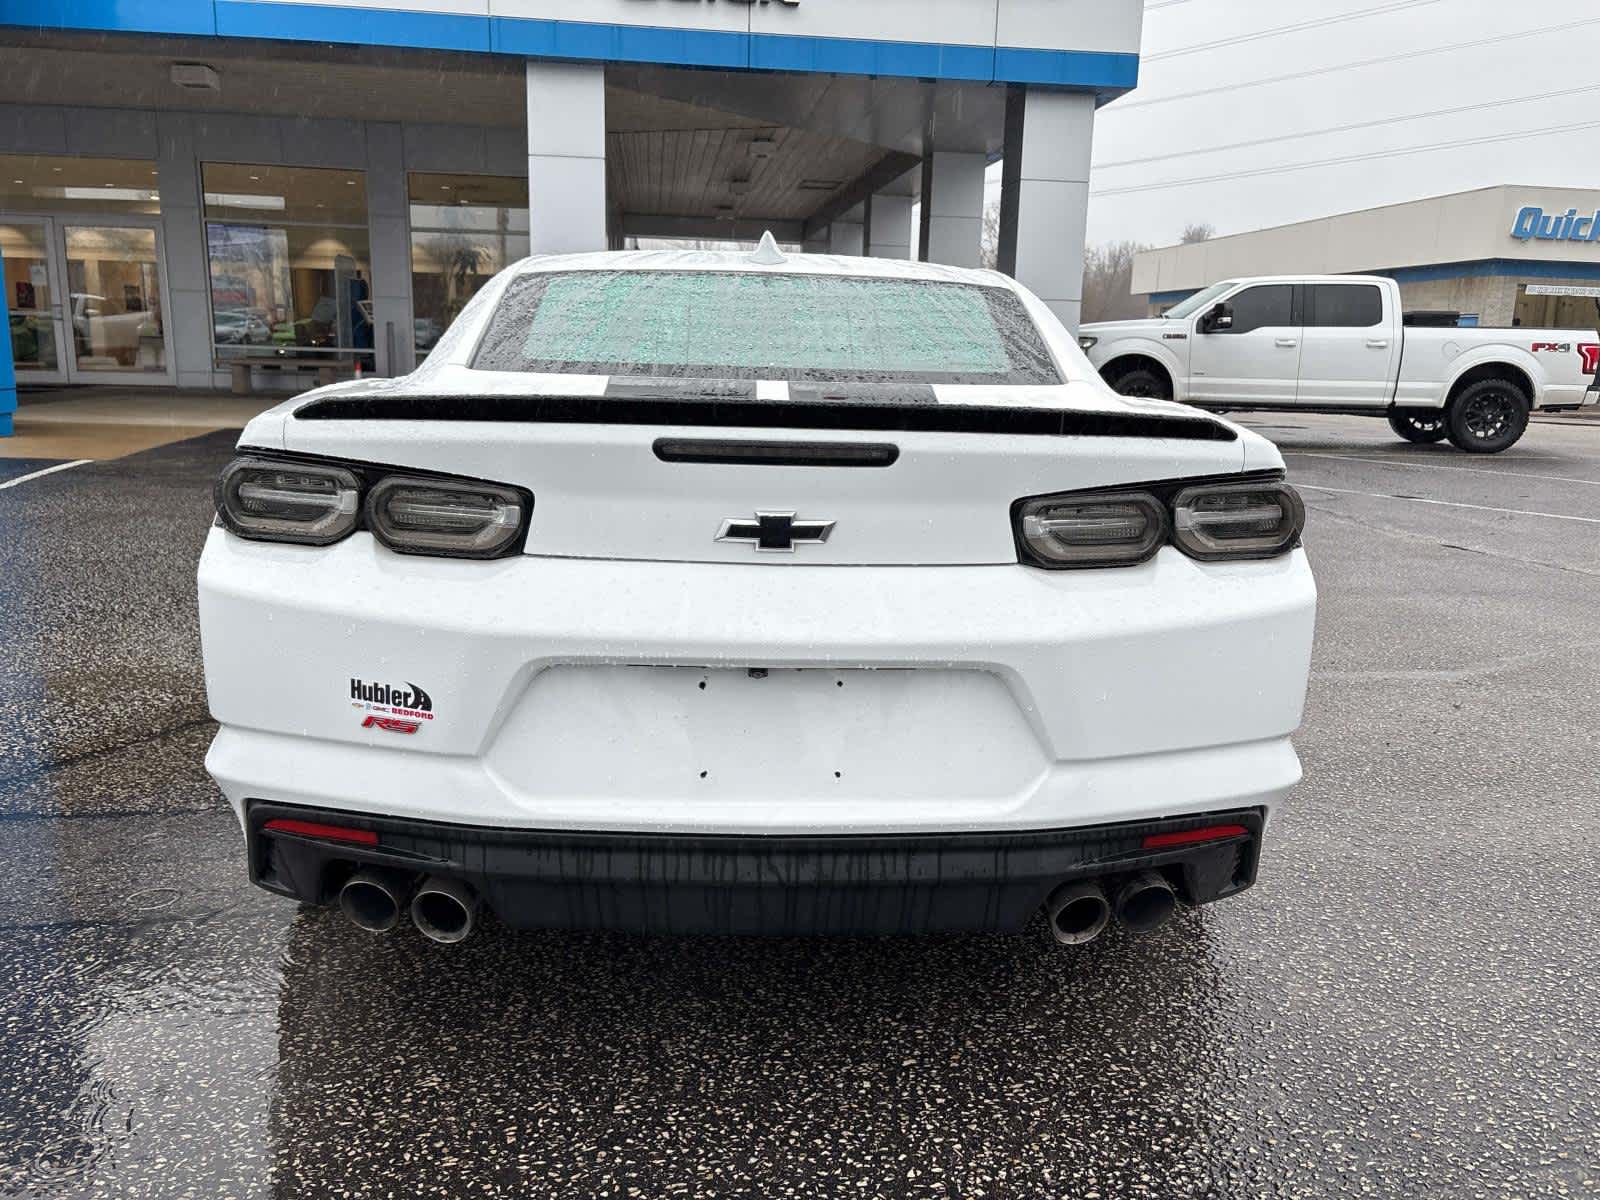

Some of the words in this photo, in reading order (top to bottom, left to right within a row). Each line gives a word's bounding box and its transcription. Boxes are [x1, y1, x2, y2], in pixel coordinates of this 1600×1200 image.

[1531, 343, 1570, 352] FX4
[350, 678, 411, 708] Hubler
[392, 707, 434, 720] BEDFORD
[361, 714, 422, 735] RS
